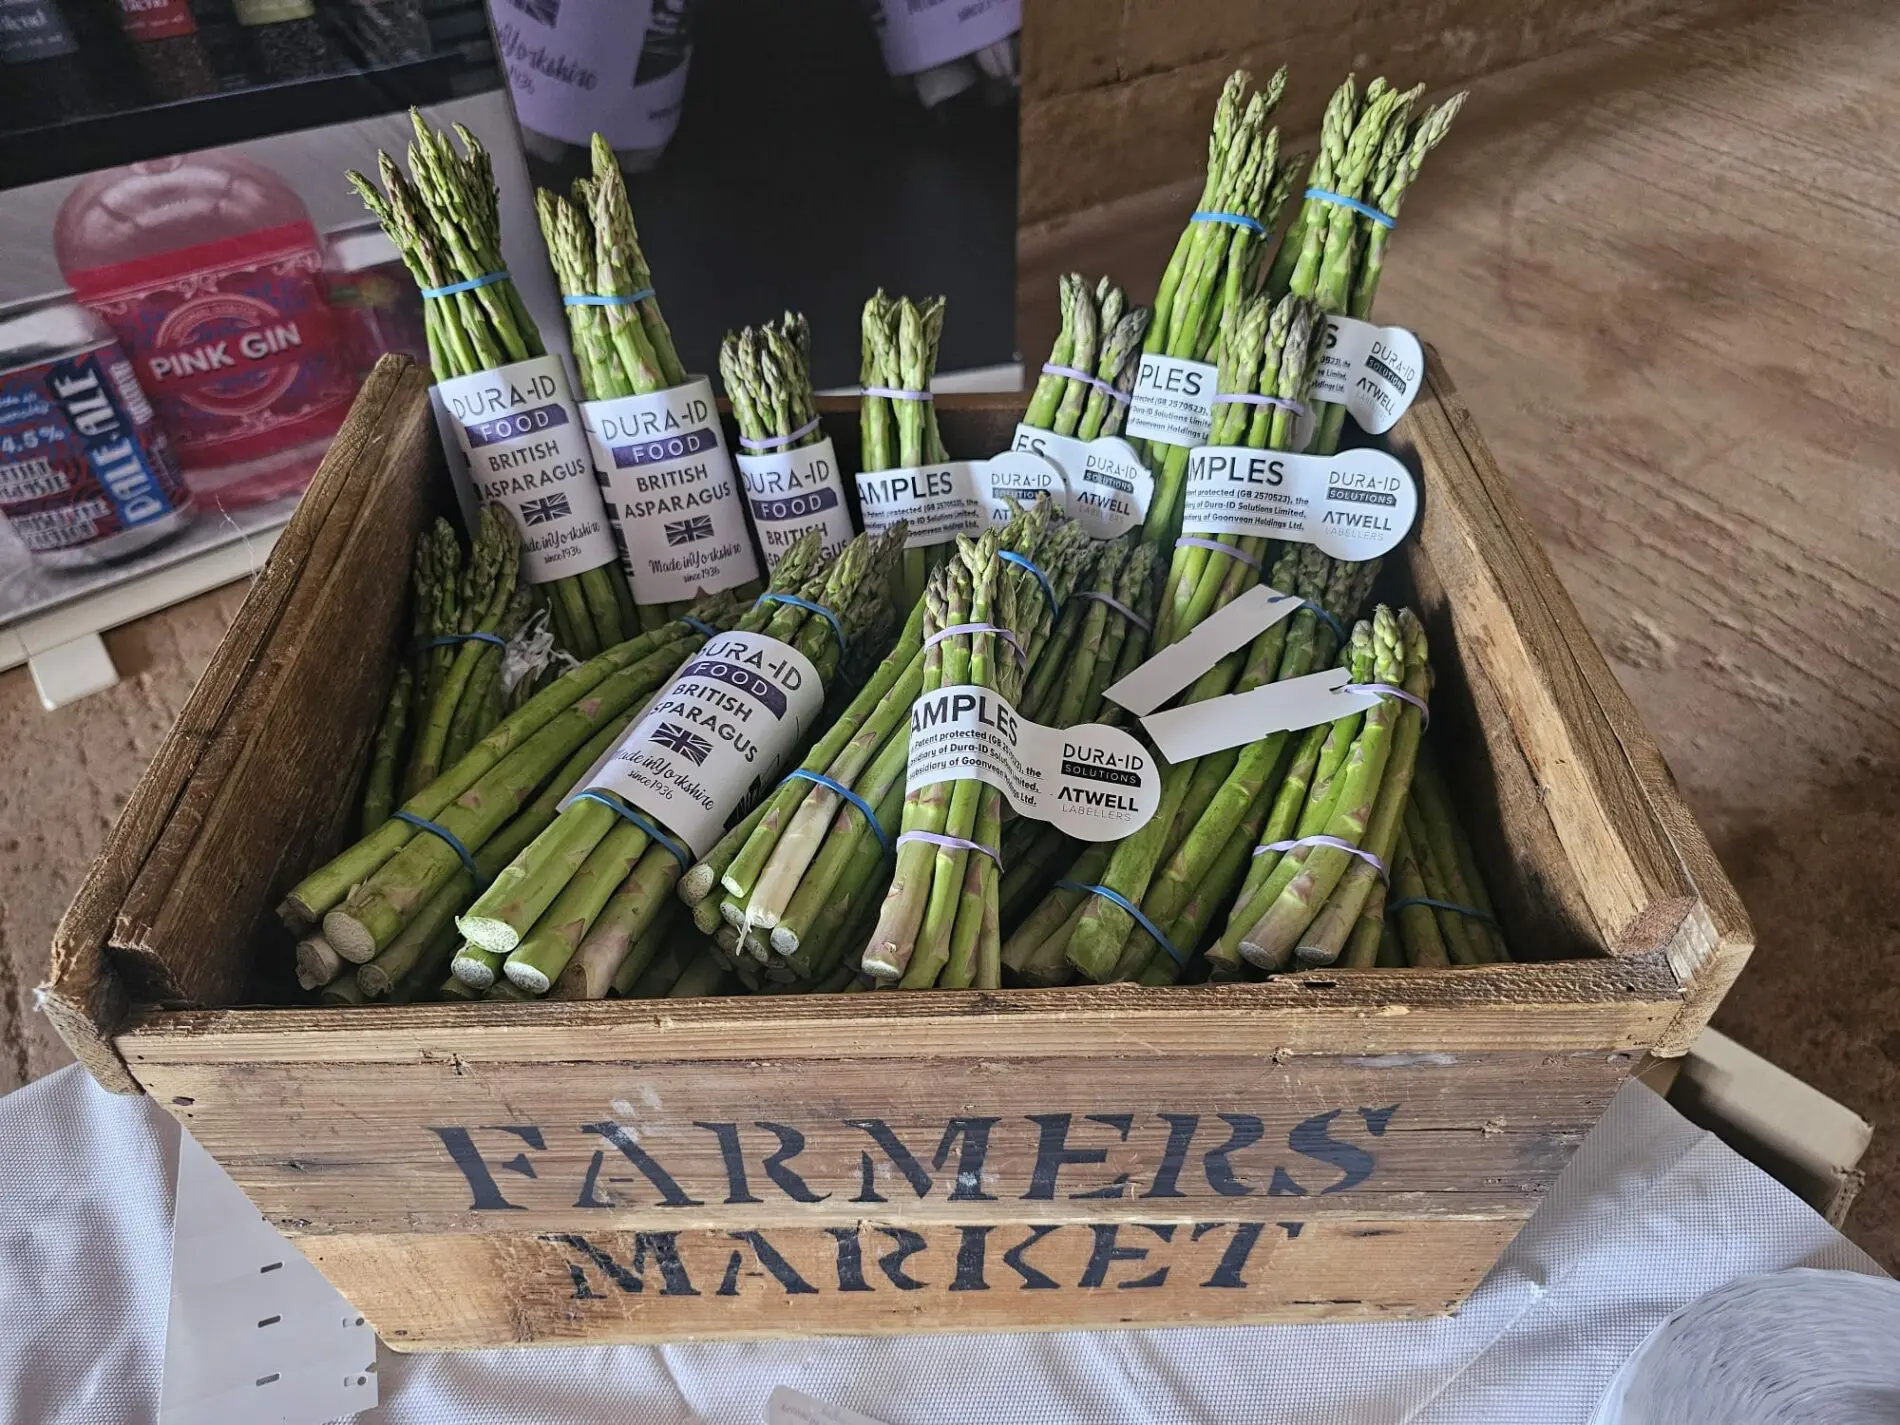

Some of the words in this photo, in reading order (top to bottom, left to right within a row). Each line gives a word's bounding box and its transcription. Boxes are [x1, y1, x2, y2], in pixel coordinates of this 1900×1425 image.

[149, 340, 236, 381] PINK
[239, 321, 302, 360] GIN
[1370, 340, 1416, 382] DURA-ID
[452, 375, 557, 421] DURA-ID
[1356, 377, 1397, 416] ATWELL
[480, 410, 550, 443] FOOD
[601, 400, 708, 441] DURA-ID
[488, 439, 560, 473] BRITISH
[632, 435, 700, 464] FOOD
[90, 438, 163, 525] PALE
[484, 458, 586, 500] ASPARAGUS
[637, 464, 709, 493] BRITISH
[991, 473, 1052, 487] DURA-ID
[1085, 471, 1132, 492] SOLUTIONS
[1086, 455, 1137, 480] DURA-ID
[1329, 471, 1401, 491] DURA-ID
[625, 481, 732, 519] ASPARAGUS
[761, 495, 821, 518] FOOD
[1077, 491, 1130, 516] ATWELL
[1238, 502, 1272, 514] Solutions
[1329, 489, 1393, 505] SOLUTIONS
[1322, 510, 1391, 531] ATWELL
[693, 662, 768, 696] FOOD
[672, 684, 753, 722] BRITISH
[939, 729, 987, 742] protected
[1026, 767, 1042, 778] the
[950, 743, 988, 754] Dura-ID
[1063, 743, 1144, 771] DURA-ID
[949, 756, 959, 767] of
[1020, 792, 1037, 806] Ltd.
[1065, 764, 1136, 784] SOLUTIONS
[1057, 786, 1139, 812] ATWELL
[1062, 804, 1132, 822] LABELLERS
[422, 1103, 1401, 1210] FARMERS
[538, 1221, 1304, 1300] MARKET
